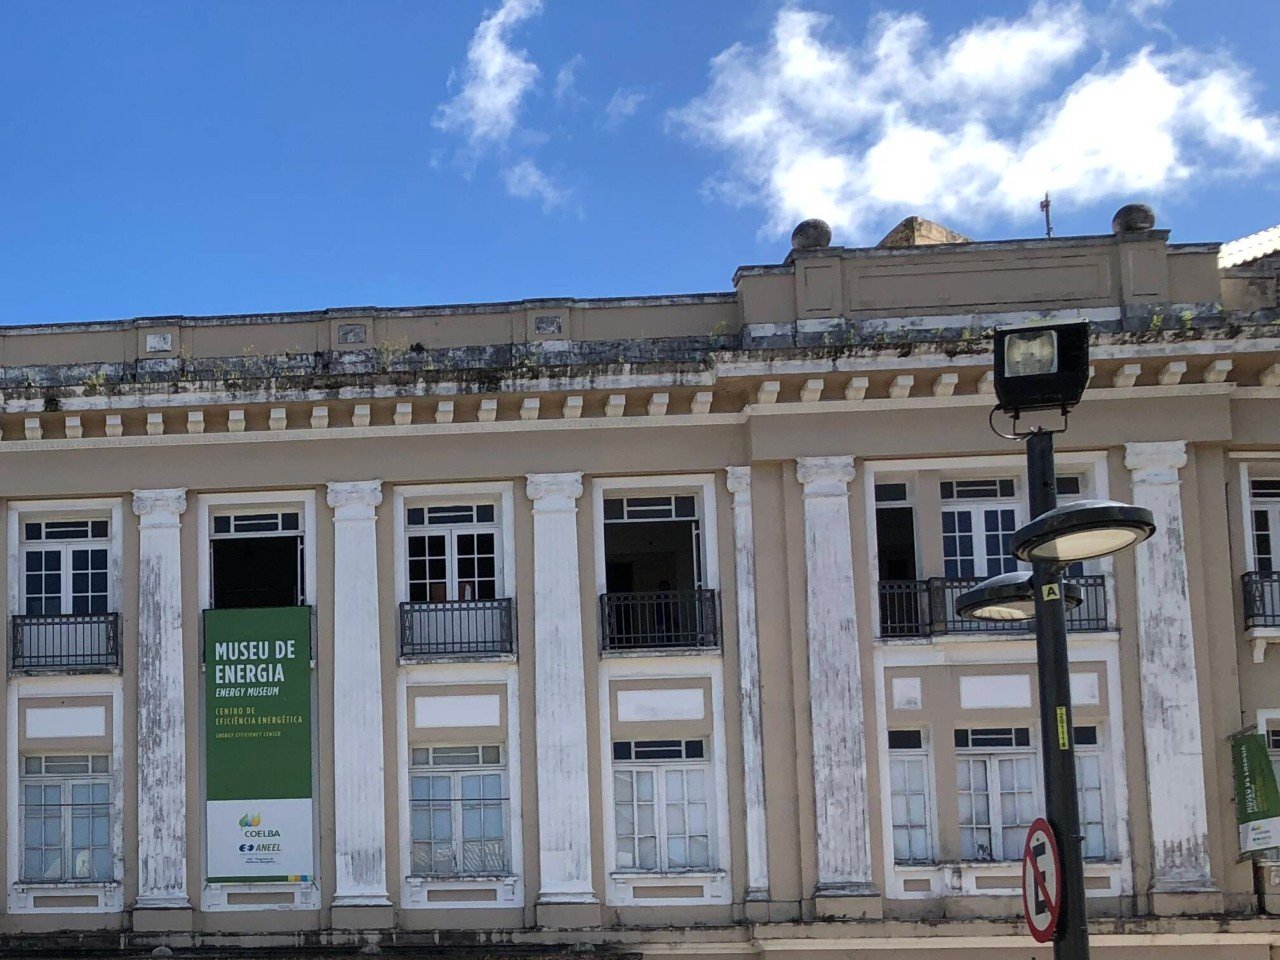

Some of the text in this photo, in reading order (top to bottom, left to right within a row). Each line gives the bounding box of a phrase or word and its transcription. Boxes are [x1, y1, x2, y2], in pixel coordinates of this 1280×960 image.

[1047, 587, 1058, 599] A
[215, 640, 296, 660] MUSEU DE
[215, 663, 285, 683] ENERGIA
[215, 686, 280, 697] ENERGY MUSEUM
[215, 706, 256, 715] CENTRO DE
[215, 715, 303, 726] EFICIÊNCIA ENERGÉTICA
[1032, 841, 1047, 916] E
